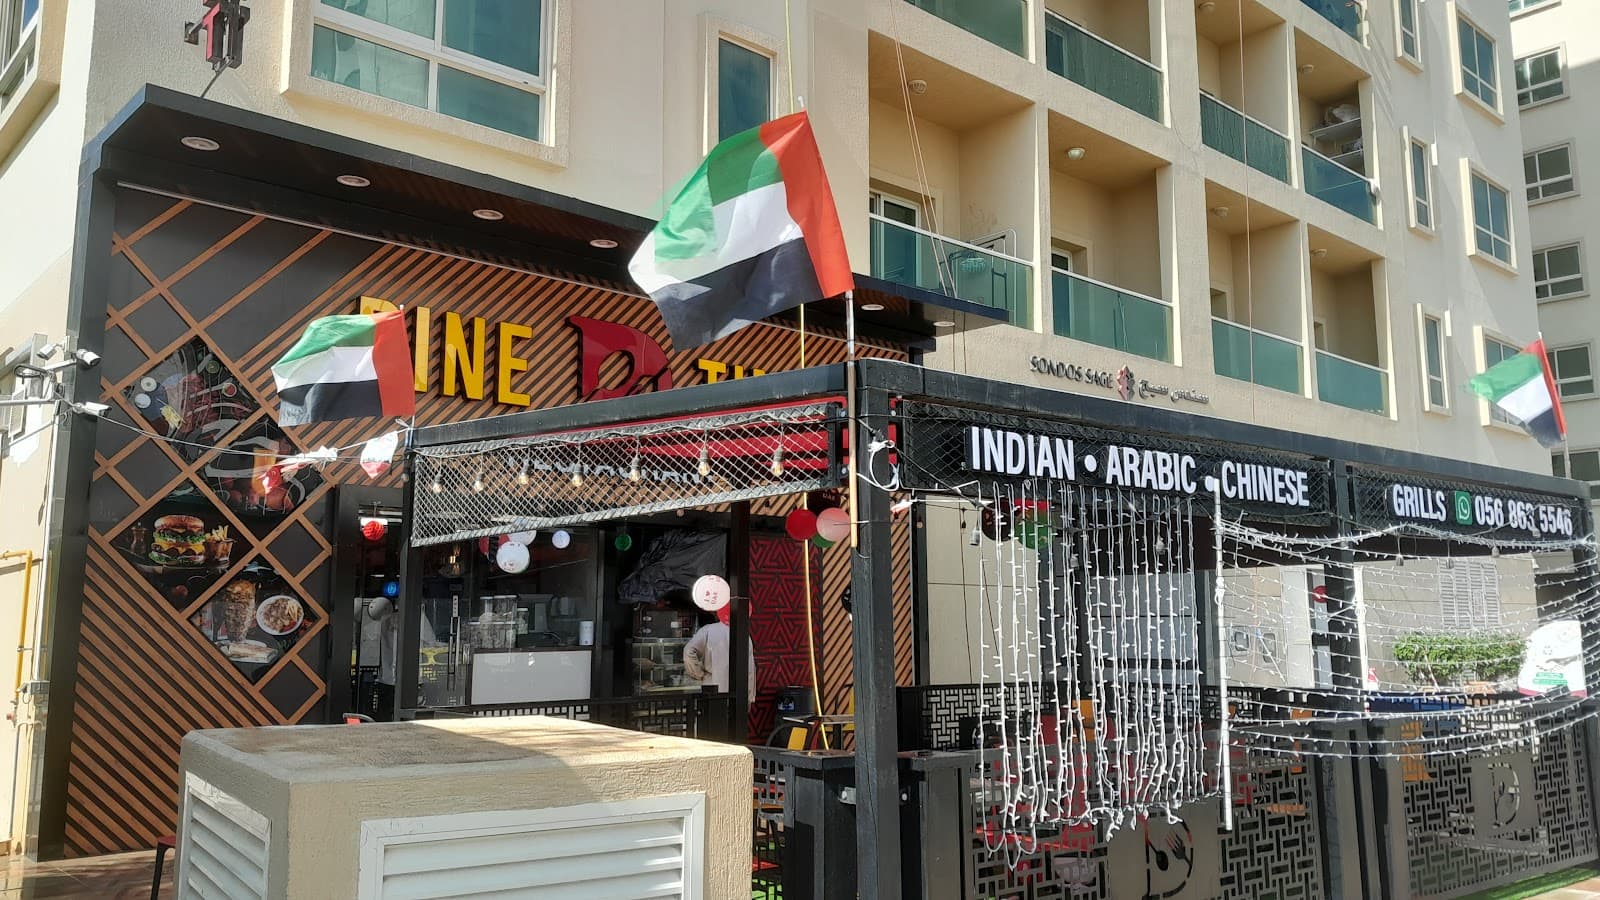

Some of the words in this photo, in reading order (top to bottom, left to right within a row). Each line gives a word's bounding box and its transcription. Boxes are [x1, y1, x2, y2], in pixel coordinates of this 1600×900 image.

[356, 295, 533, 407] INE
[1030, 355, 1082, 382] SONDOS
[1085, 367, 1114, 389] SAGE
[971, 426, 1075, 481] INDIAN
[1105, 445, 1196, 494] ARABIC
[1221, 460, 1310, 507] CHINESE
[1392, 484, 1447, 522] GRILLS
[1475, 495, 1504, 527] 056
[1508, 499, 1535, 531] 863
[1539, 505, 1573, 537] 5546
